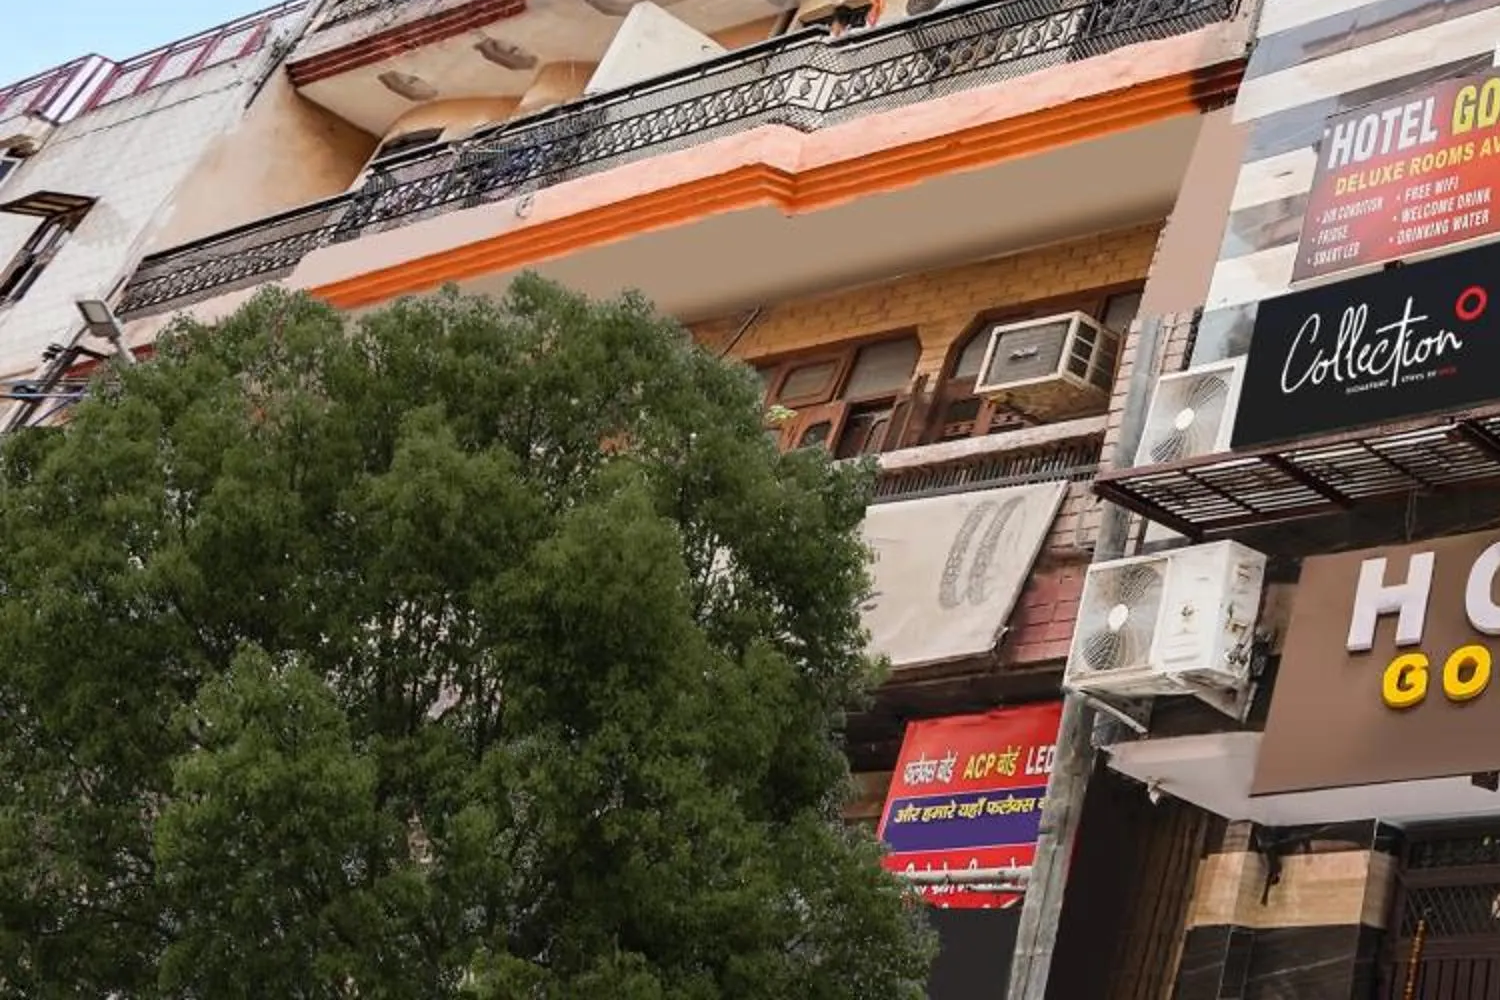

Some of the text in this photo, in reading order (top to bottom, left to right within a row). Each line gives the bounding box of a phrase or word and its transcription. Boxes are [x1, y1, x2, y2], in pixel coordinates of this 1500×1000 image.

[1327, 98, 1439, 169] HOTEL
[1335, 161, 1404, 196] DELUXE
[1409, 143, 1475, 181] ROOMS
[1401, 187, 1492, 222] WELCOME DRINK
[1405, 175, 1459, 201] FREE WIFI
[1397, 210, 1490, 245] DRINKING WATER
[1281, 296, 1463, 395] Collection
[963, 755, 997, 780] ACP
